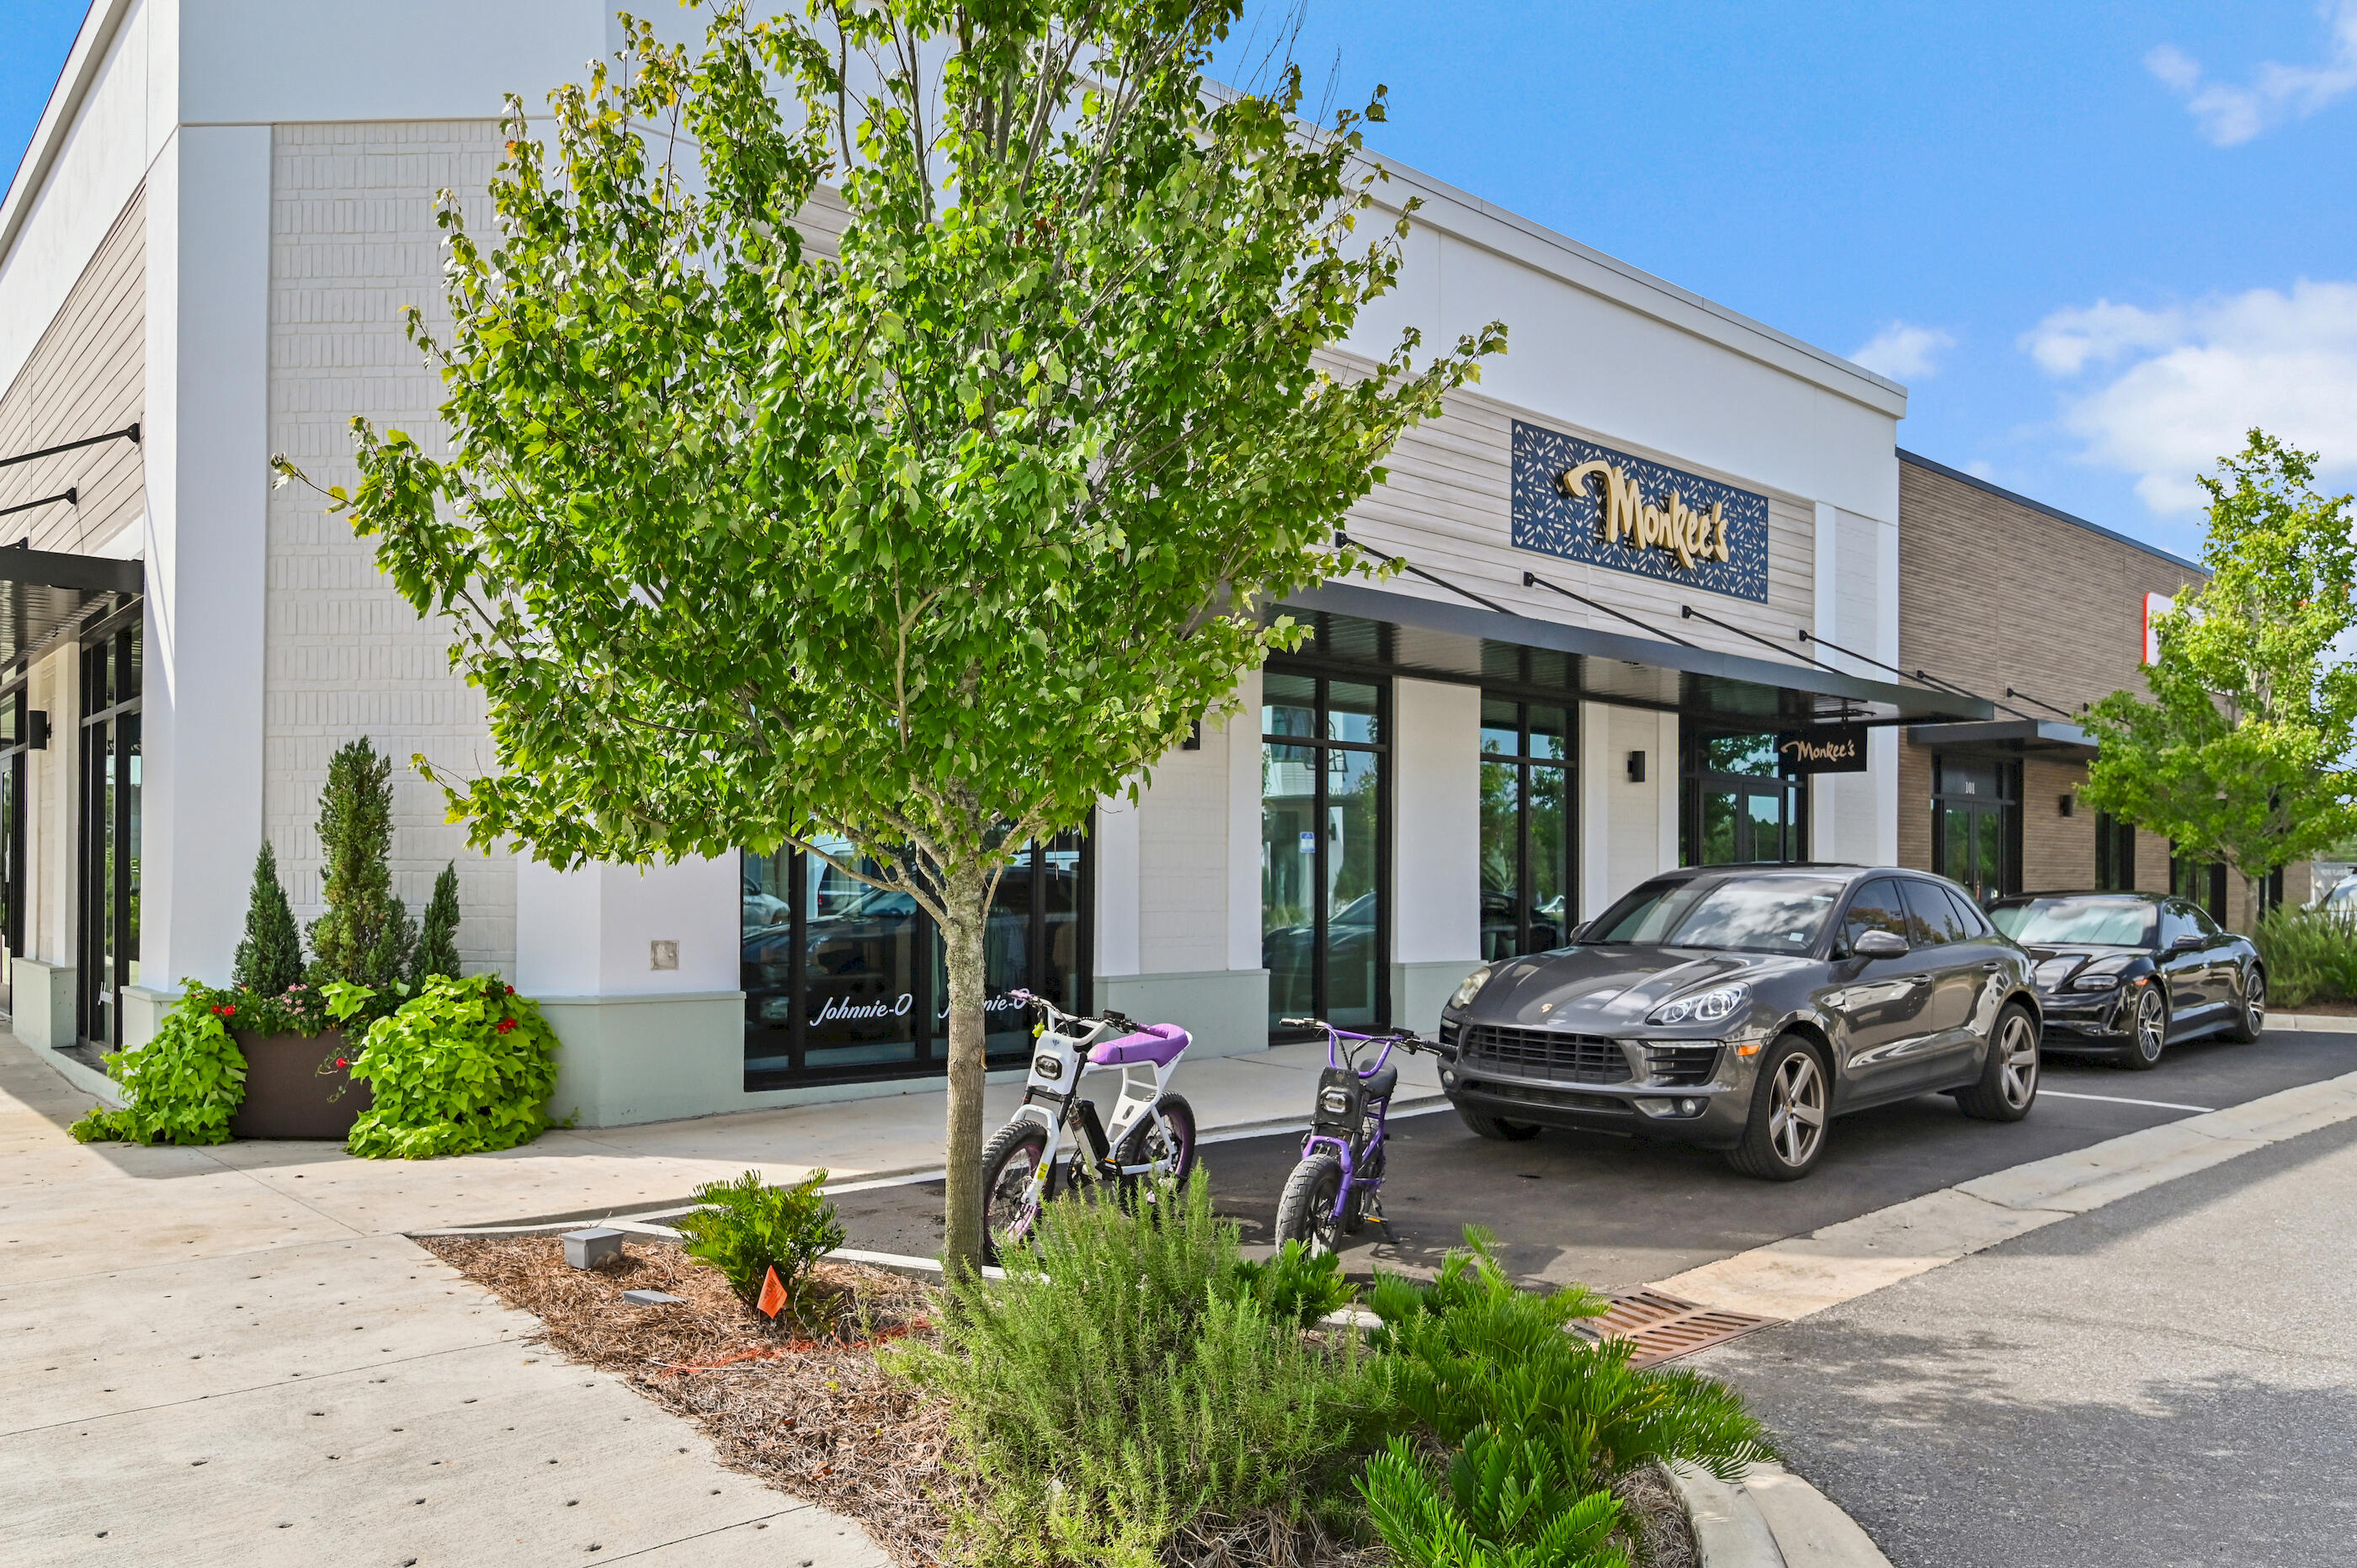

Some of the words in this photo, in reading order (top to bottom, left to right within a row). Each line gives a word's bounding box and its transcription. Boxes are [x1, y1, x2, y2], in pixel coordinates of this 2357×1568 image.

[1562, 460, 1729, 569] Monkee's
[1780, 739, 1855, 763] Monkee's
[1966, 781, 1975, 795] 101
[809, 992, 912, 1027] Johnnie-O
